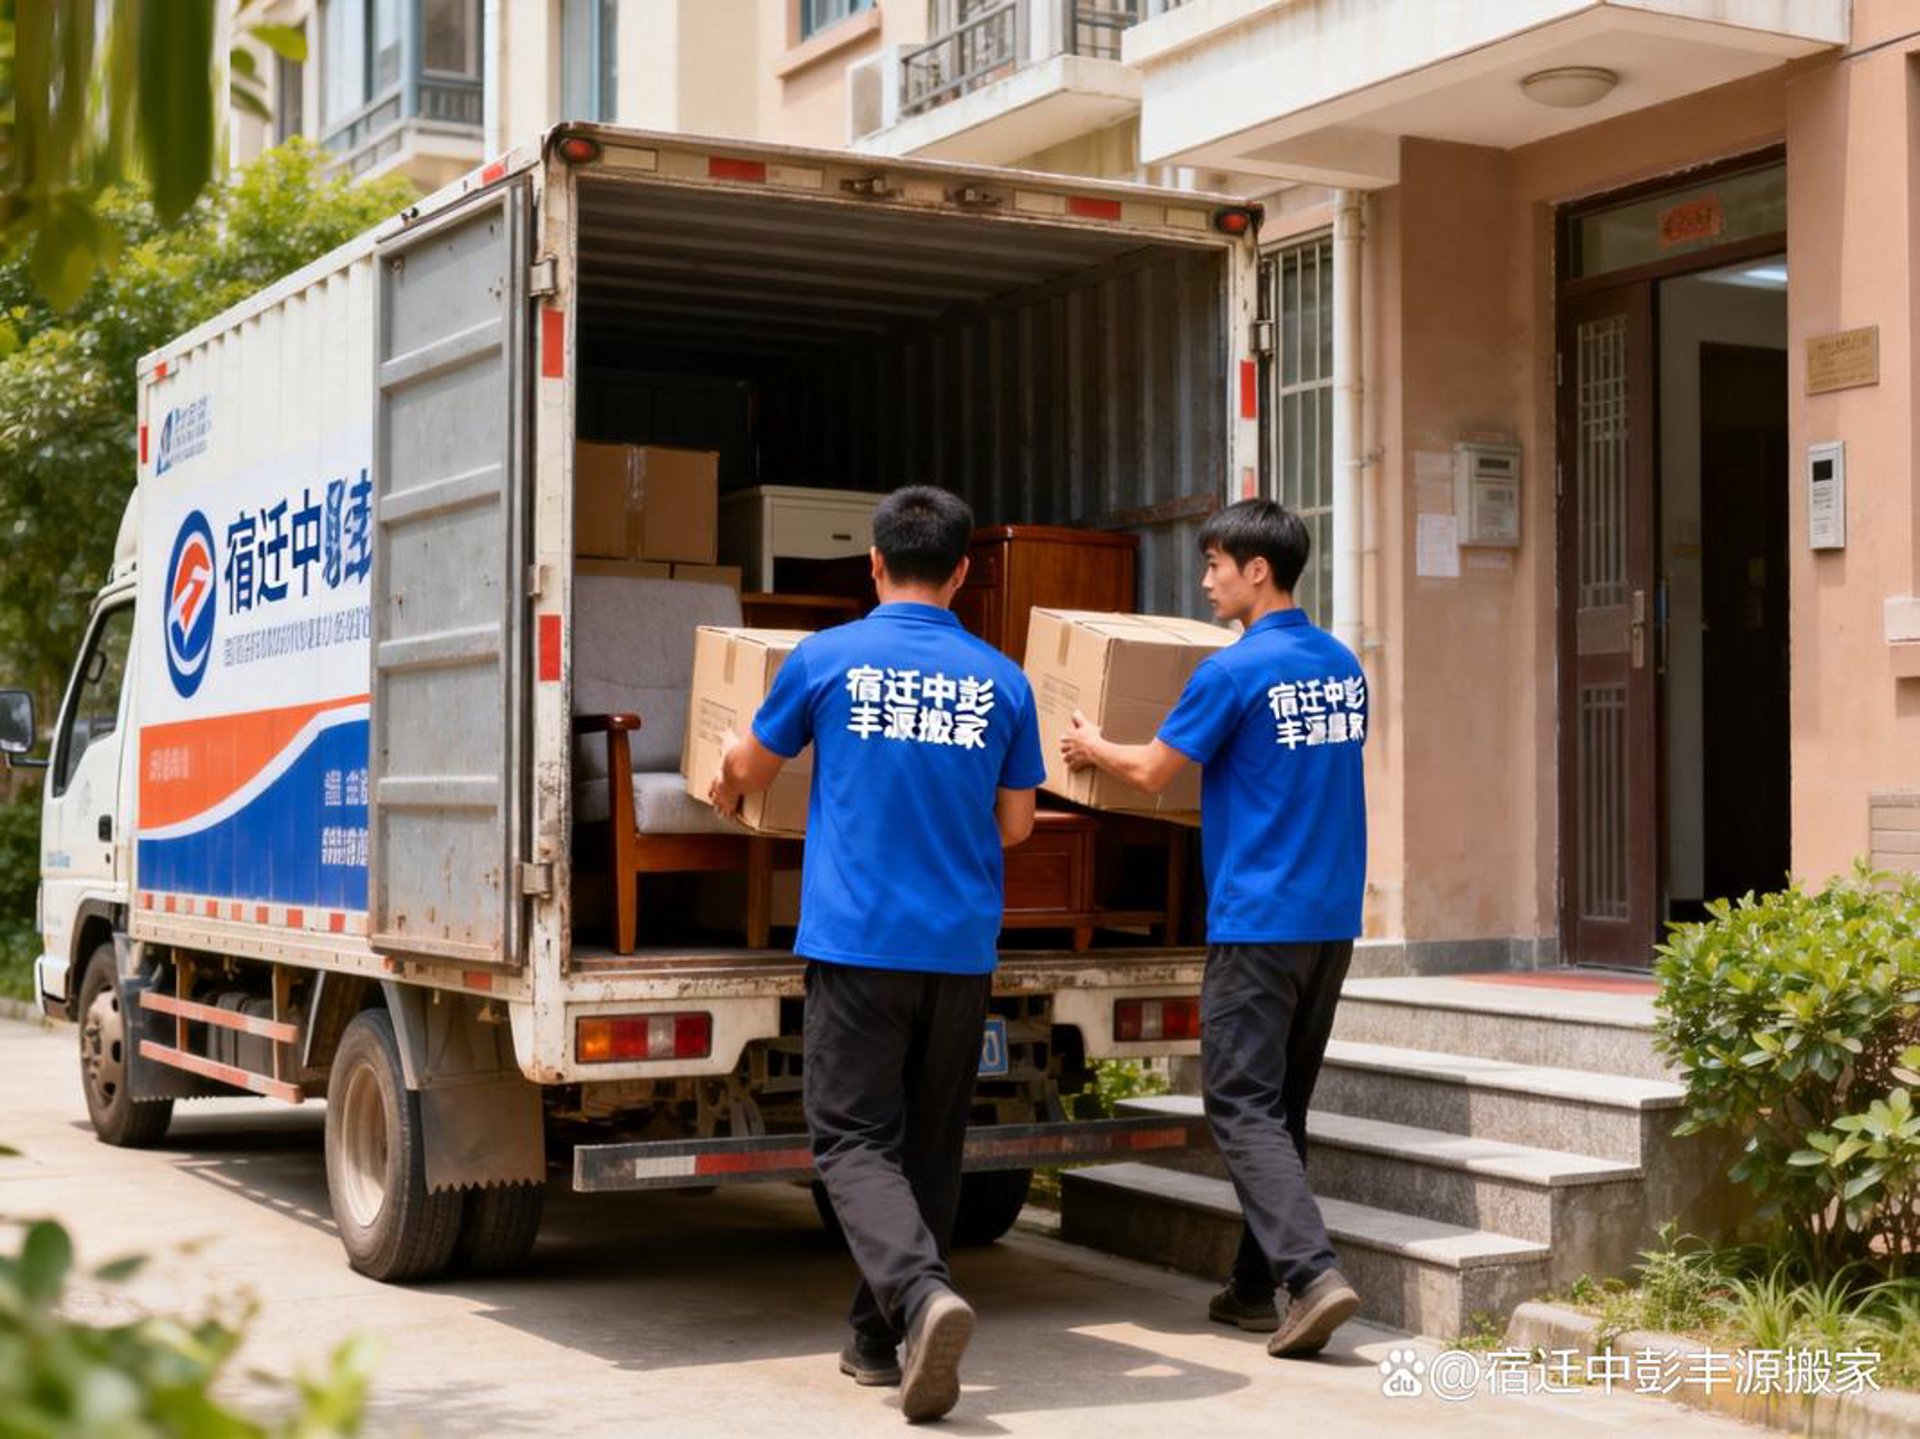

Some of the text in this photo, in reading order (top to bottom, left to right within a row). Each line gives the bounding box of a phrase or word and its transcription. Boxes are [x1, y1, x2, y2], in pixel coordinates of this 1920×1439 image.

[845, 663, 995, 715] 宿迁中彭
[1267, 675, 1365, 720] 宿迁中彭
